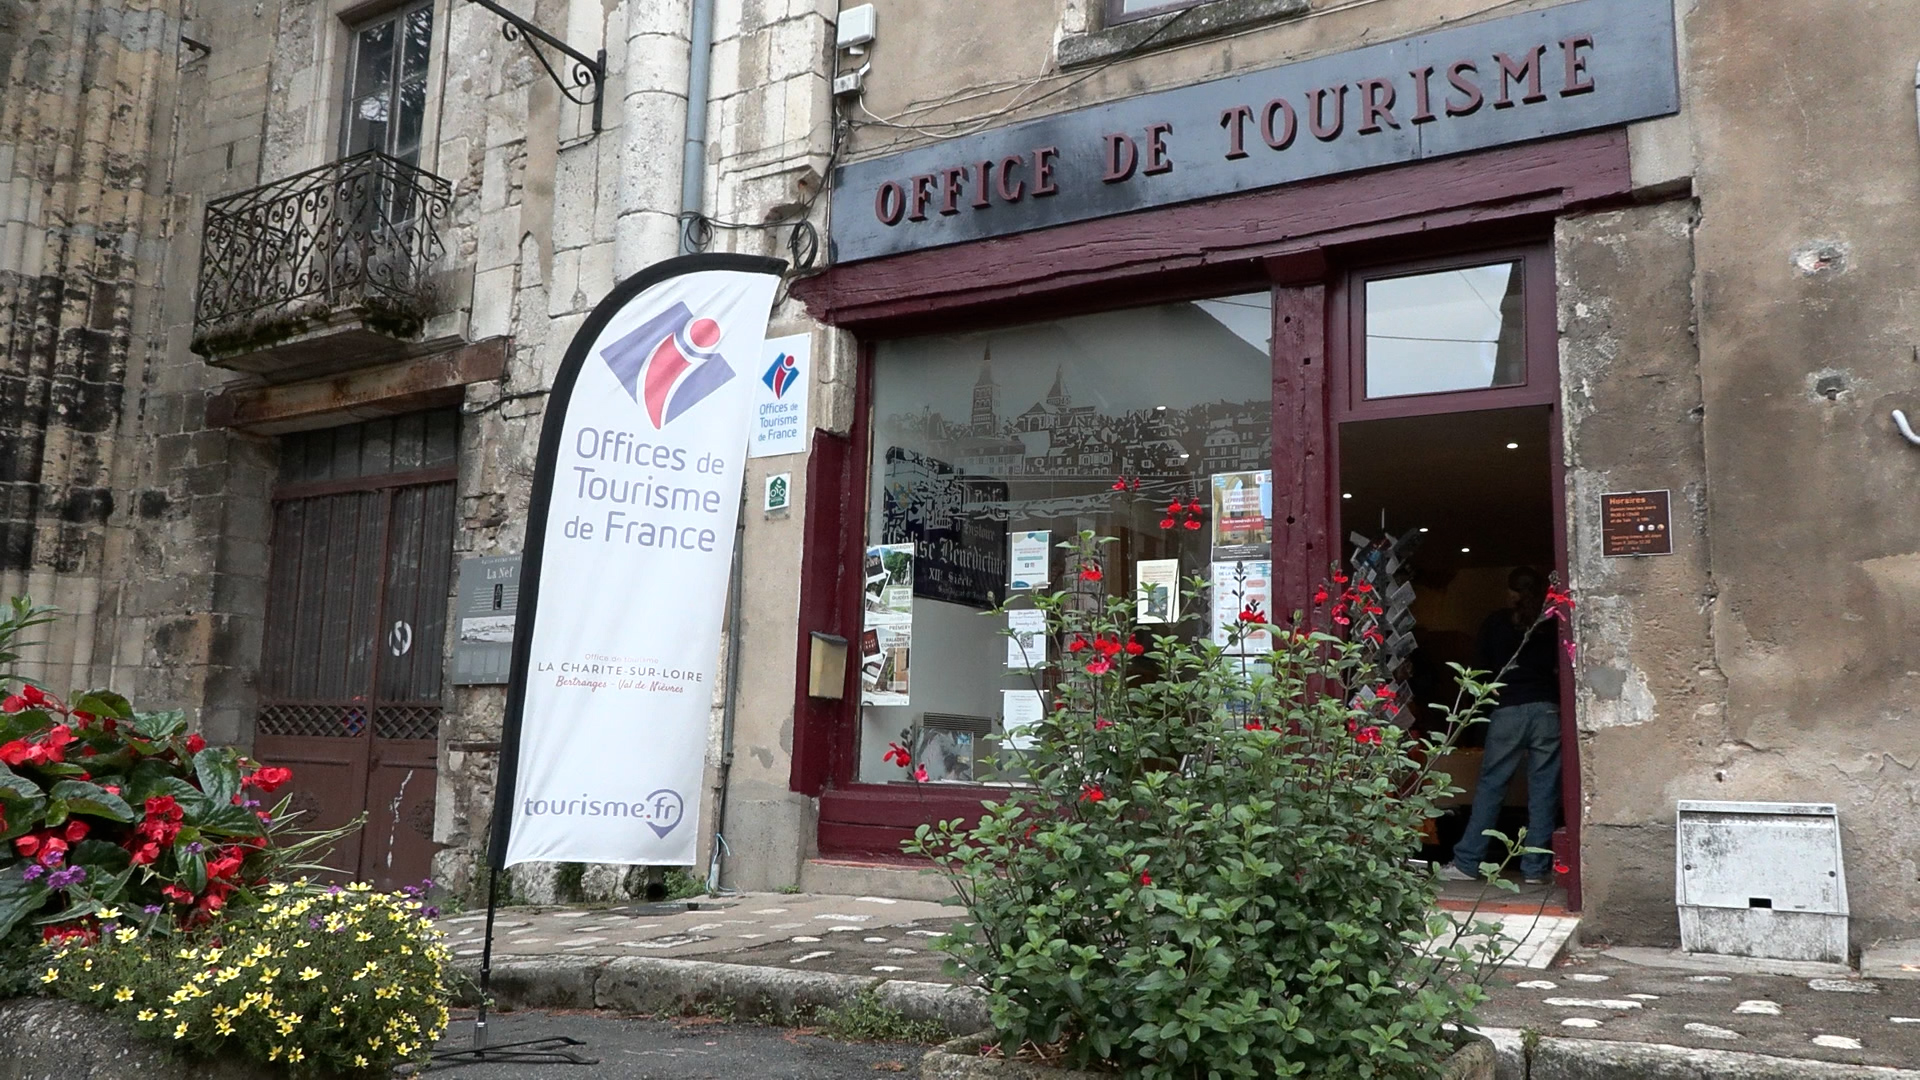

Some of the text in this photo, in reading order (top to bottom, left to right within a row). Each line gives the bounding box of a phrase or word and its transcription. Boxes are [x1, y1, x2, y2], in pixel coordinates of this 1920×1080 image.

[874, 32, 1595, 226] OFFICE DE TOURISME
[759, 403, 798, 416] Offices de
[760, 414, 798, 428] Tourisme
[758, 427, 798, 442] de France
[576, 427, 724, 475] Offices de
[573, 466, 721, 513] Tourisme
[564, 511, 716, 552] de France
[486, 566, 514, 580] La Nef
[537, 662, 703, 683] LA CHARITE-SUR-LOIRE
[556, 675, 607, 692] Bertranges
[618, 679, 632, 690] Val
[635, 679, 646, 690] de
[524, 793, 676, 821] tourisme.fr
